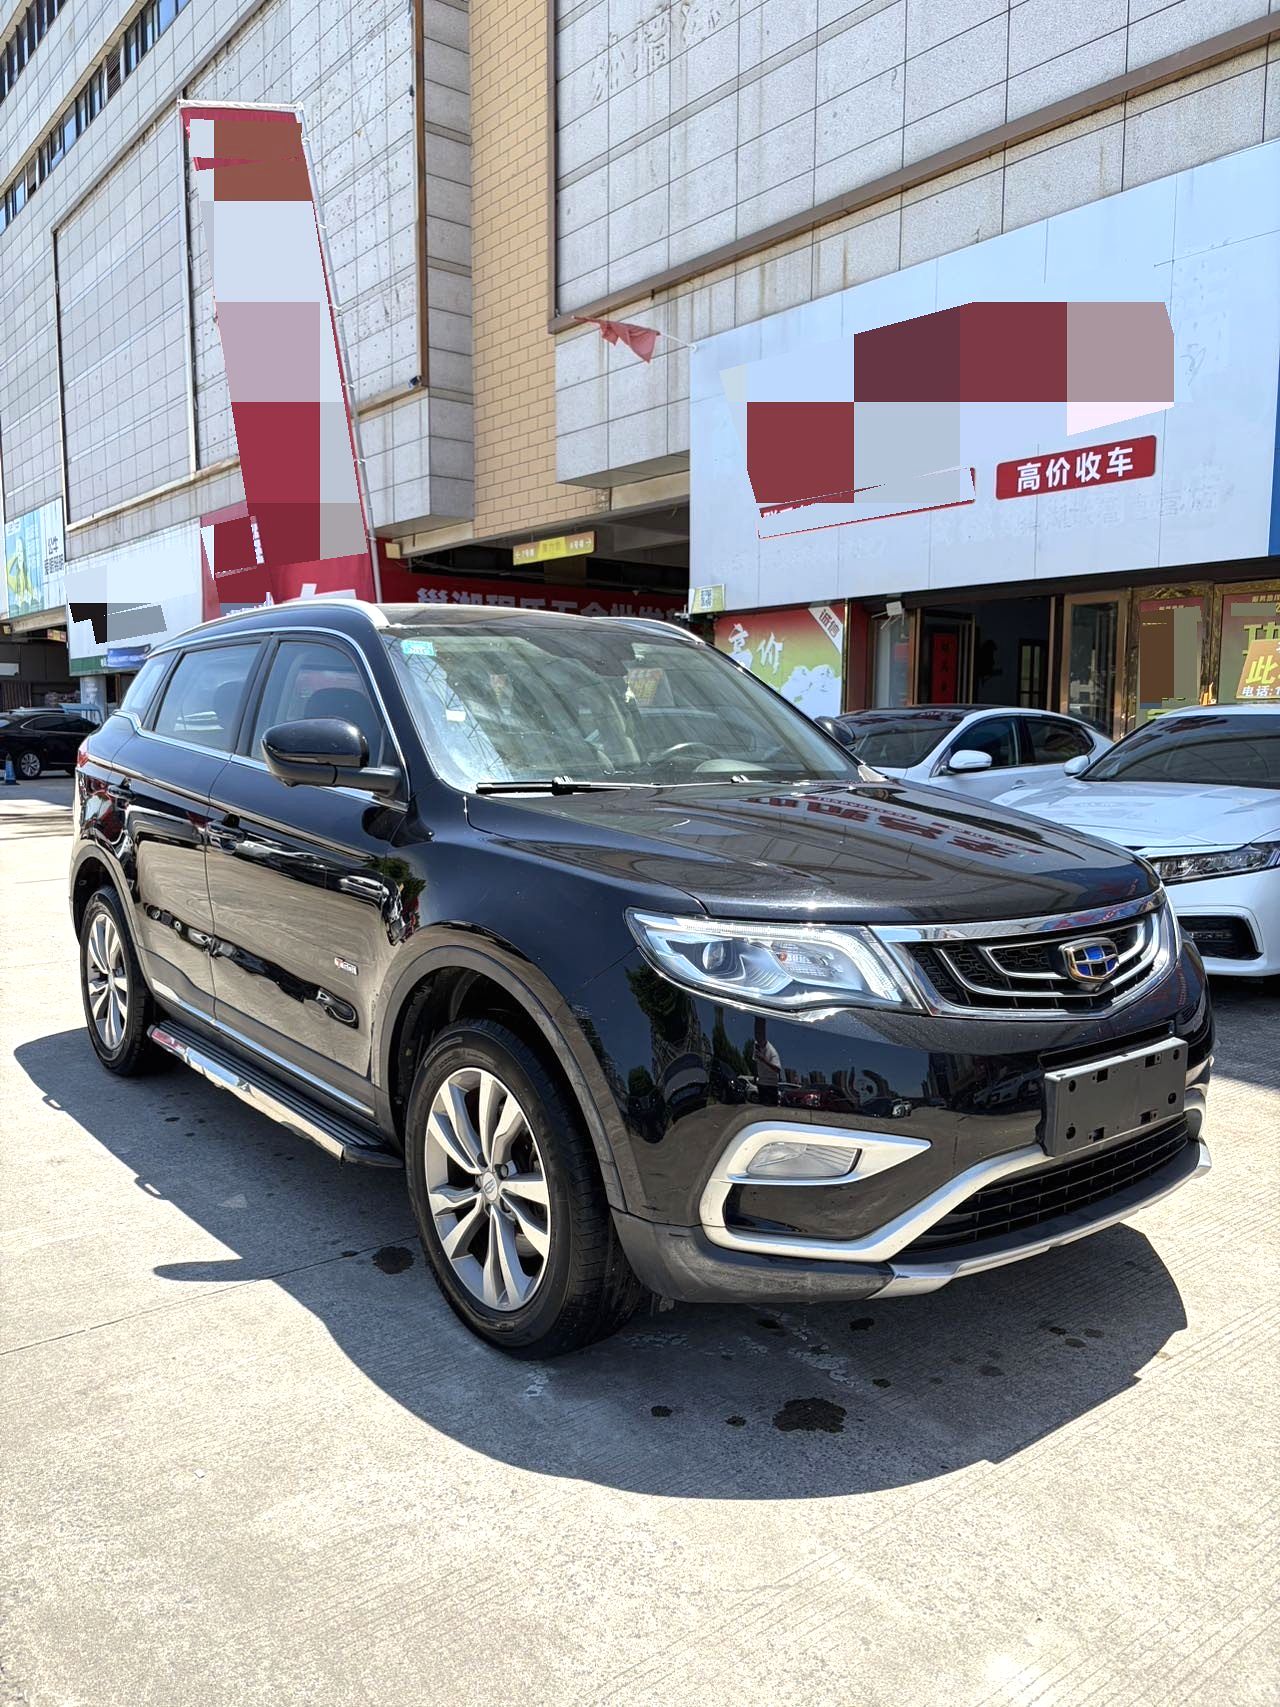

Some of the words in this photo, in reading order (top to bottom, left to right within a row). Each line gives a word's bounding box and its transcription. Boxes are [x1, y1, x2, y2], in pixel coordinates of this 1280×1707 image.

[1017, 446, 1134, 493] 高价收车
[818, 609, 840, 637] 诚信
